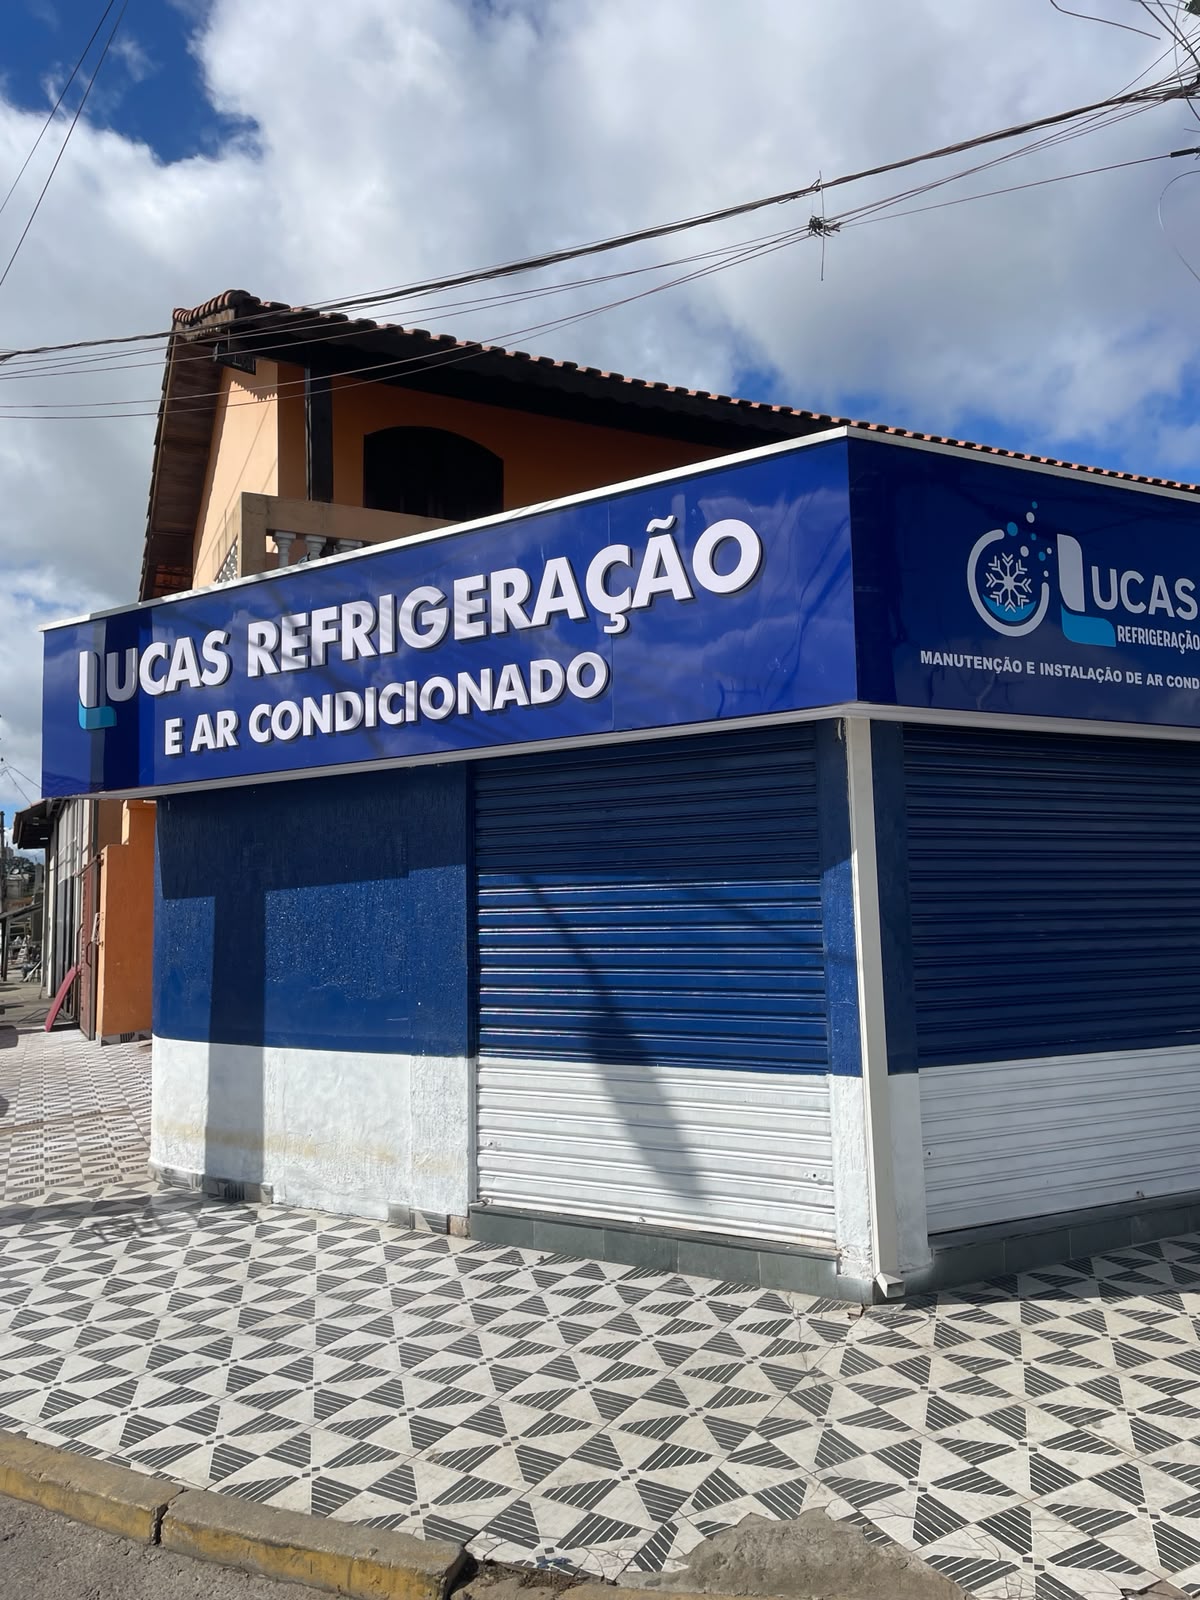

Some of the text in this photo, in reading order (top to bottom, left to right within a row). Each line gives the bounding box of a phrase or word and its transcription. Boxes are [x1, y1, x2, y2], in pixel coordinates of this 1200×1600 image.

[78, 515, 763, 730] LUCAS REFRIGERAÇÃO
[1057, 533, 1199, 647] LUCAS
[1117, 625, 1200, 654] REFRIGERAÇÃO
[164, 651, 609, 756] E AR CONDICIONADO
[920, 650, 1023, 674] MANUTENÇÃO
[1026, 662, 1035, 675] E
[1040, 662, 1123, 684] INSTALAÇÃO
[1126, 671, 1143, 685] DE
[1146, 674, 1164, 688] AR
